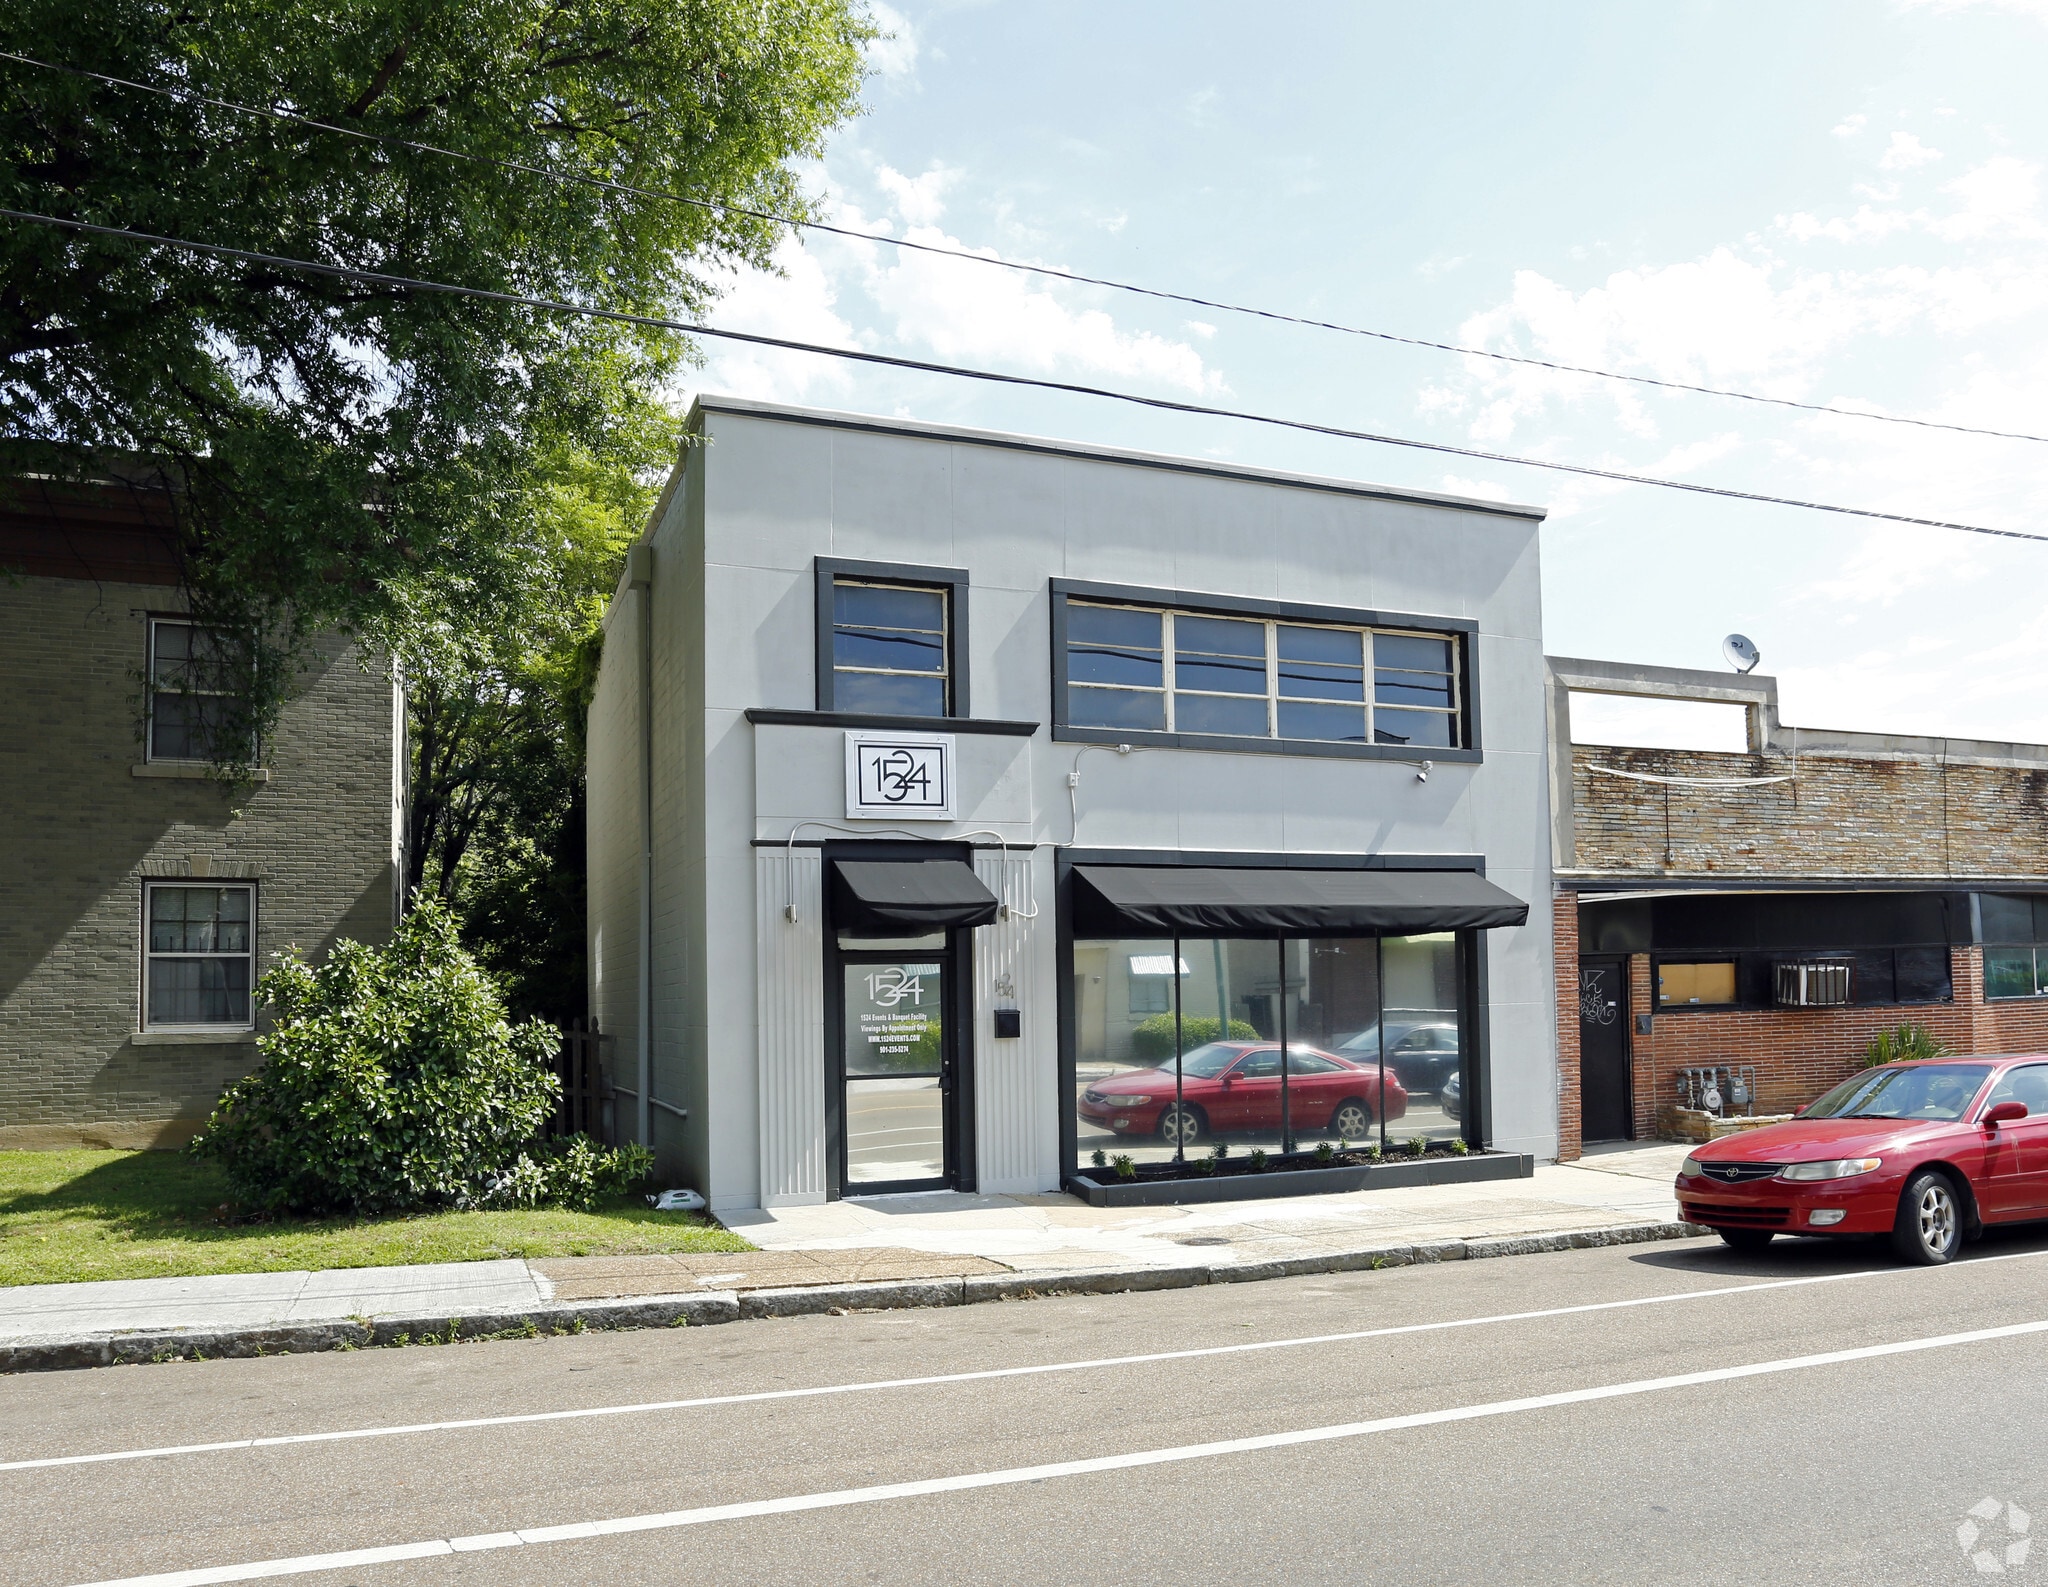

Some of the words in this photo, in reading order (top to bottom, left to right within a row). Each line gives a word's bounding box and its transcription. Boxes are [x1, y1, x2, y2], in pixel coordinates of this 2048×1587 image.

[872, 750, 931, 801] 1524
[864, 967, 924, 1006] 1524
[861, 1013, 871, 1021] 1524
[872, 1013, 886, 1021] Events
[888, 1013, 892, 1021] &
[892, 1013, 910, 1022] Banquet
[911, 1013, 927, 1022] Facility
[861, 1024, 881, 1033] Viewings
[882, 1024, 888, 1033] By
[889, 1024, 916, 1033] Appointment
[917, 1023, 927, 1032] Only
[868, 1035, 921, 1043] WWW.1524EVENTS.COM
